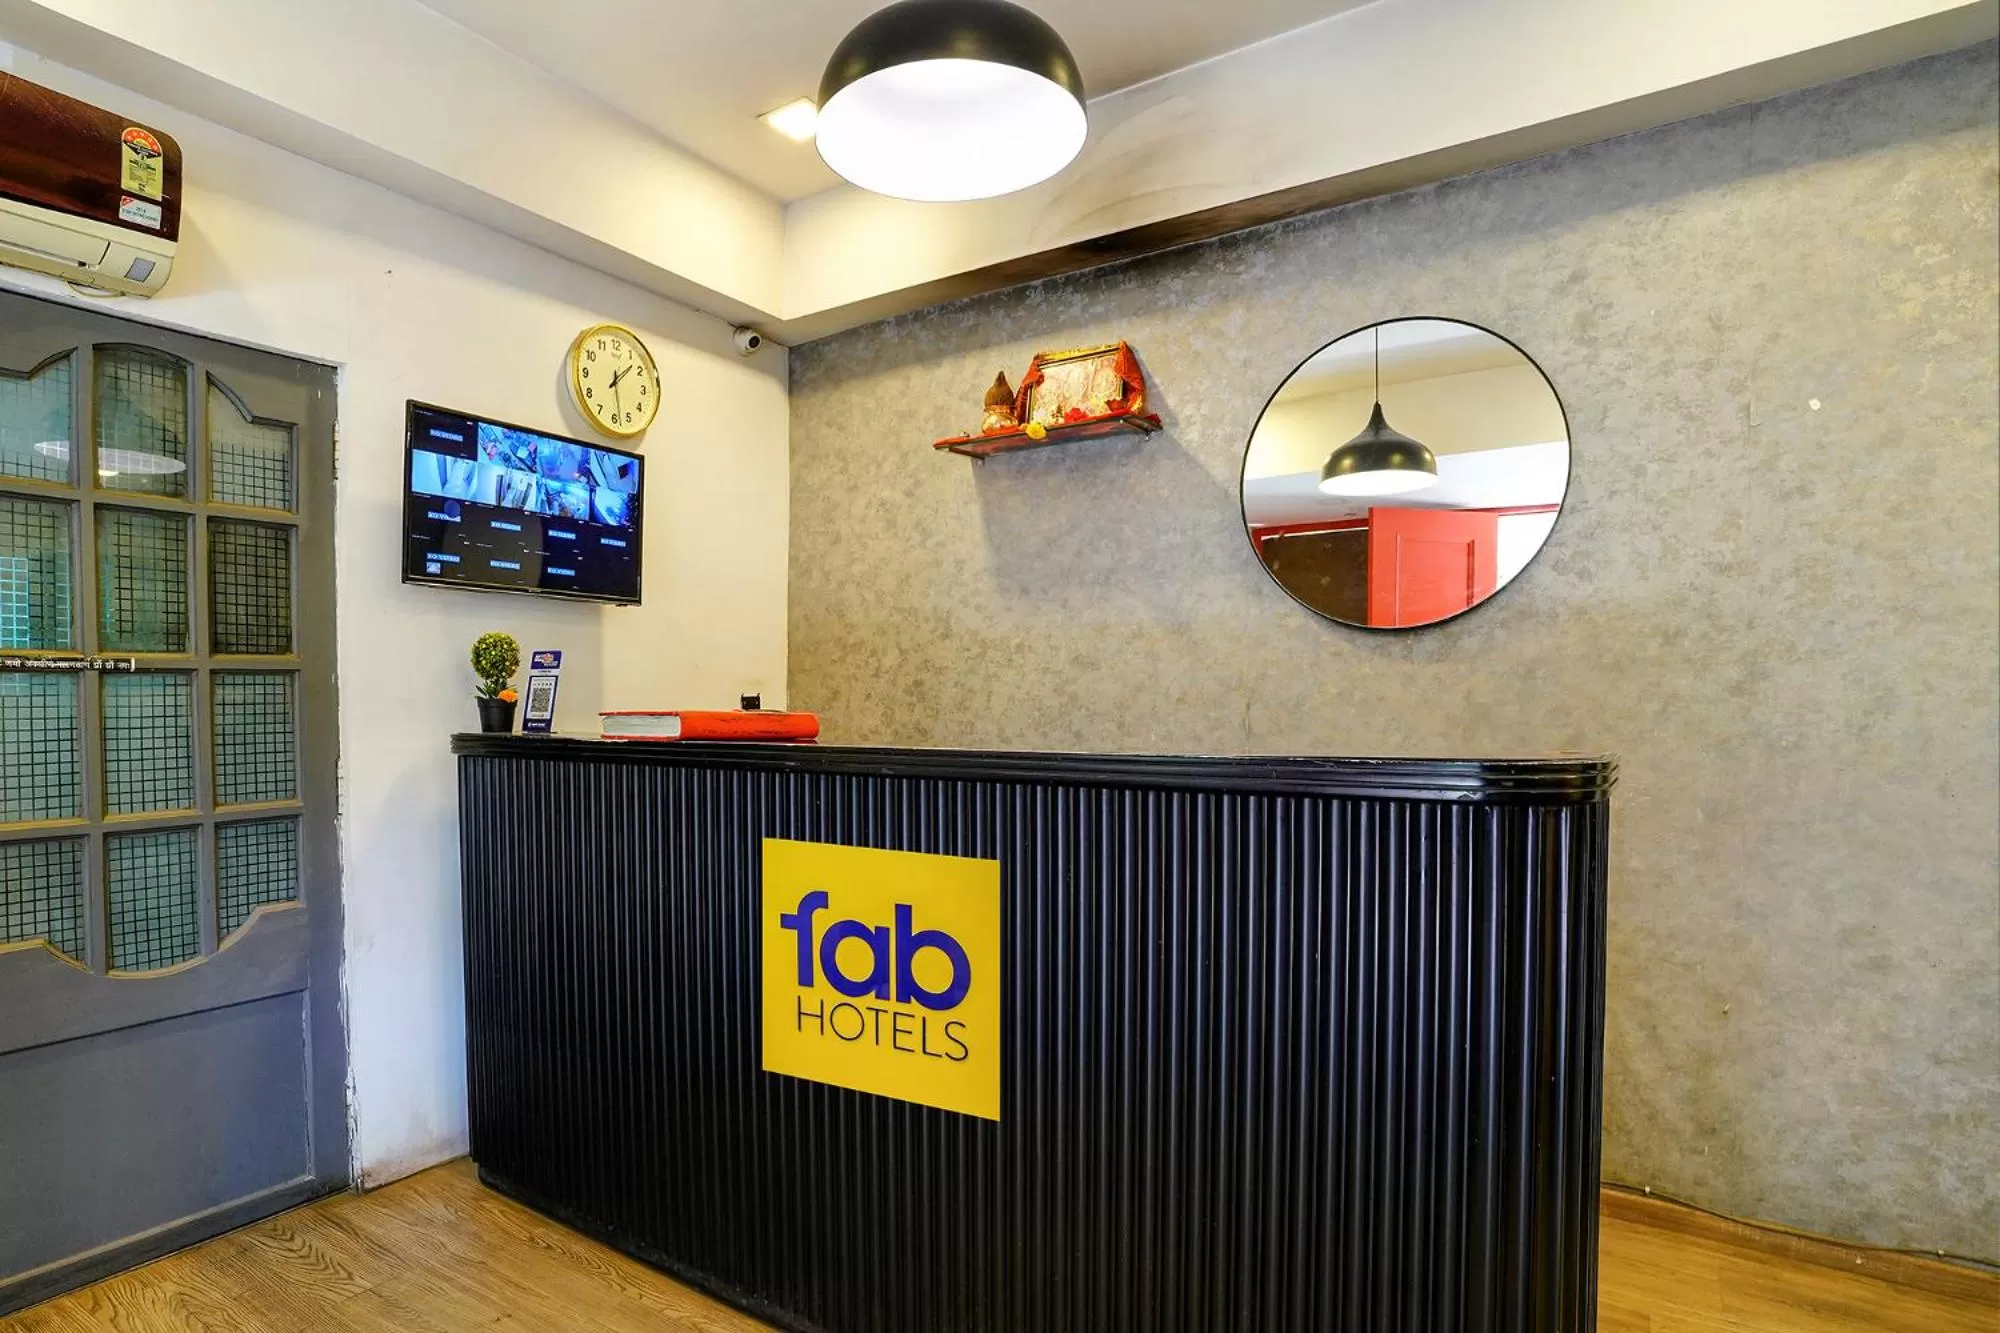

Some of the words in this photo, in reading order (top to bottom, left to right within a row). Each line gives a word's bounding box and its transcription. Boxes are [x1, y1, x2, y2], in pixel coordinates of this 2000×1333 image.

[597, 339, 606, 351] 11
[611, 339, 621, 351] 12
[585, 349, 597, 362] 10
[628, 350, 633, 360] 1
[582, 367, 589, 378] 9
[636, 365, 644, 377] 2
[586, 387, 593, 399] 8
[640, 384, 647, 396] 3
[596, 403, 603, 415] 7
[636, 402, 642, 413] 4
[611, 413, 618, 424] 6
[625, 412, 632, 423] 5
[780, 890, 971, 1011] fab
[797, 995, 969, 1062] HOTELS
